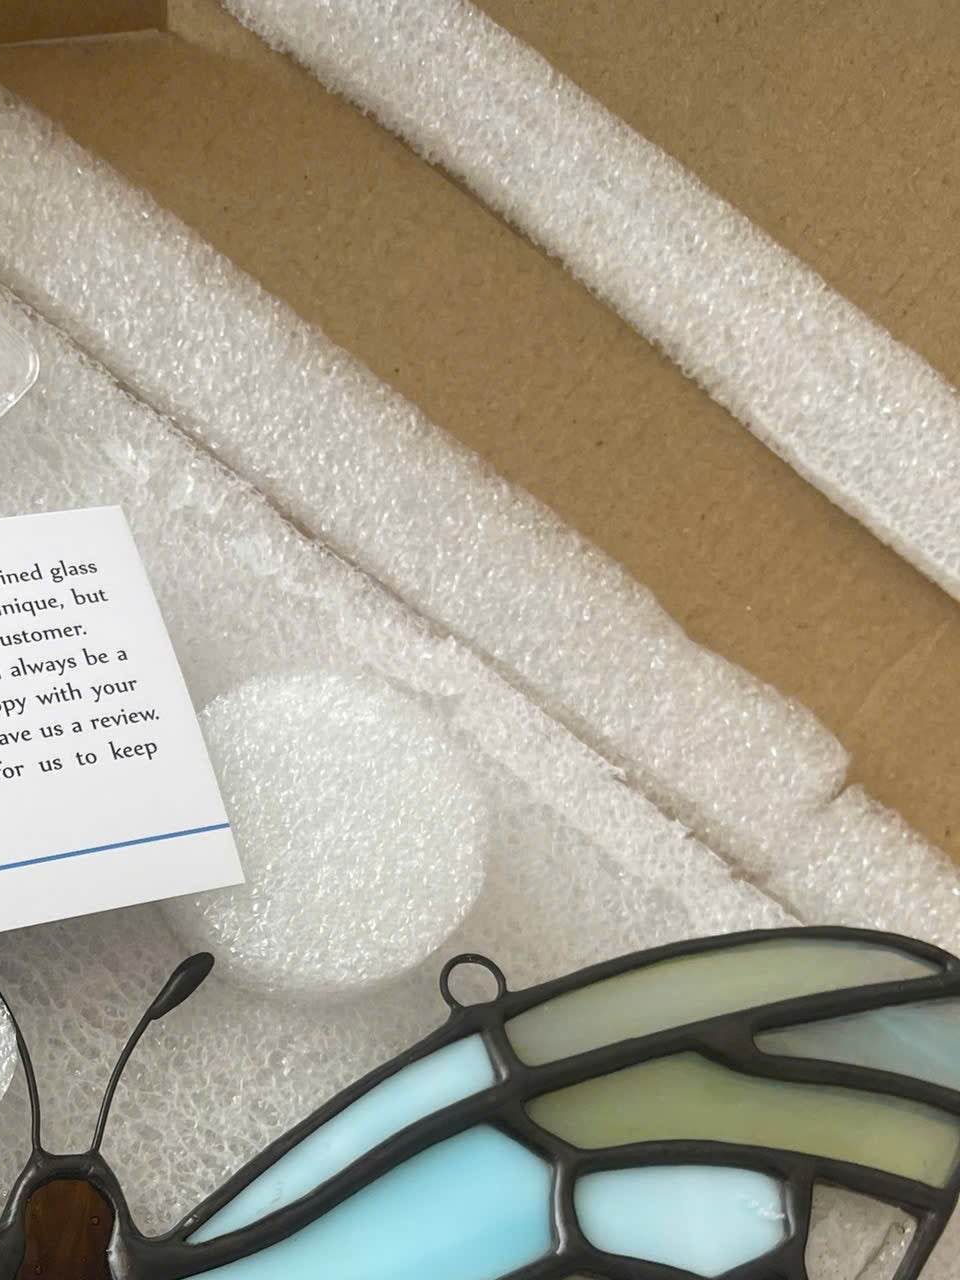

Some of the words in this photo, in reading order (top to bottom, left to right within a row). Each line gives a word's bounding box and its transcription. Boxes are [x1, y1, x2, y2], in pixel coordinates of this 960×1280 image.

[50, 559, 98, 583] glass
[70, 588, 109, 605] but
[10, 657, 77, 677] always
[82, 648, 110, 666] be
[116, 650, 128, 661] a
[35, 682, 82, 705] with
[90, 679, 137, 703] your
[39, 724, 64, 738] us
[71, 721, 83, 733] a
[90, 708, 160, 730] review.
[38, 758, 63, 773] us
[75, 752, 97, 766] to
[108, 741, 158, 761] keep
